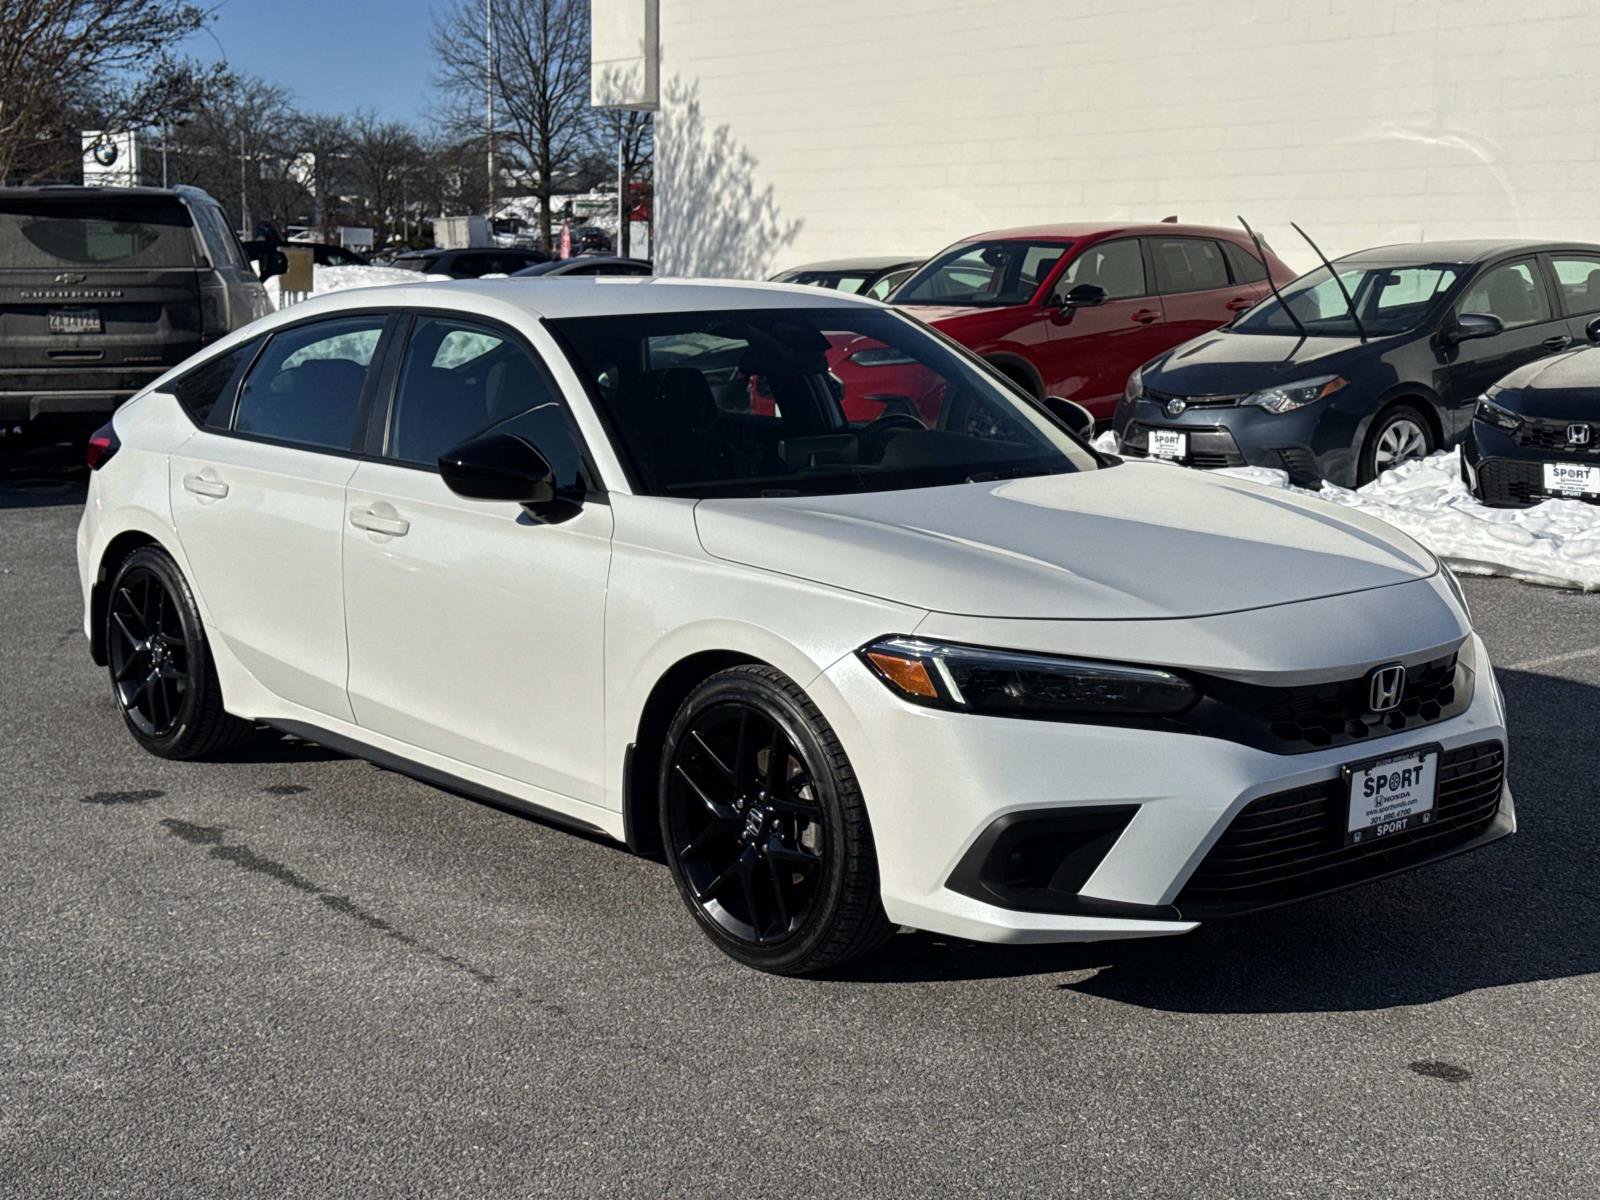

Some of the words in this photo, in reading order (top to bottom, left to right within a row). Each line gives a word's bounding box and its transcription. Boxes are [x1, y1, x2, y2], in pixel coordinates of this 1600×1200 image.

[1155, 435, 1179, 444] SPORT
[1553, 468, 1591, 479] SPORT
[1363, 765, 1423, 798] SPORT
[1384, 791, 1411, 803] HONDA
[1376, 819, 1408, 836] SPORT
